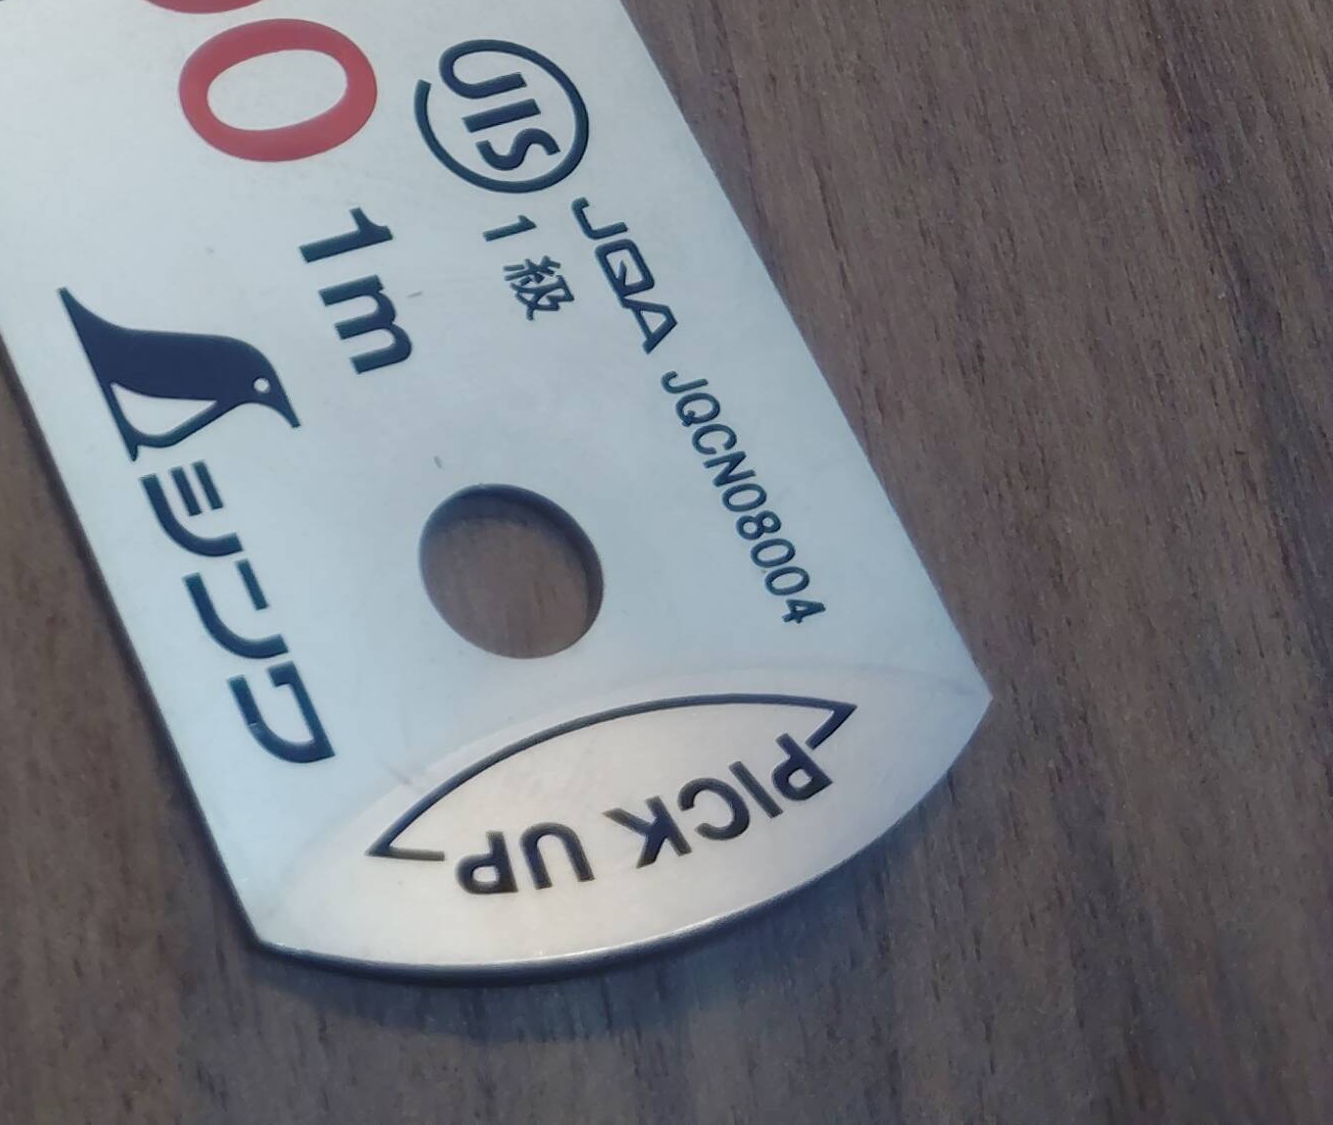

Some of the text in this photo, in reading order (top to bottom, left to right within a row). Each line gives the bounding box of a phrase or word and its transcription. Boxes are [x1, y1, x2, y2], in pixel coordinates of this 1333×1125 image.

[413, 39, 589, 194] JIS
[571, 196, 826, 625] JQA JQCN08004
[139, 460, 336, 764] シンワ
[455, 733, 834, 895] PICK UP
